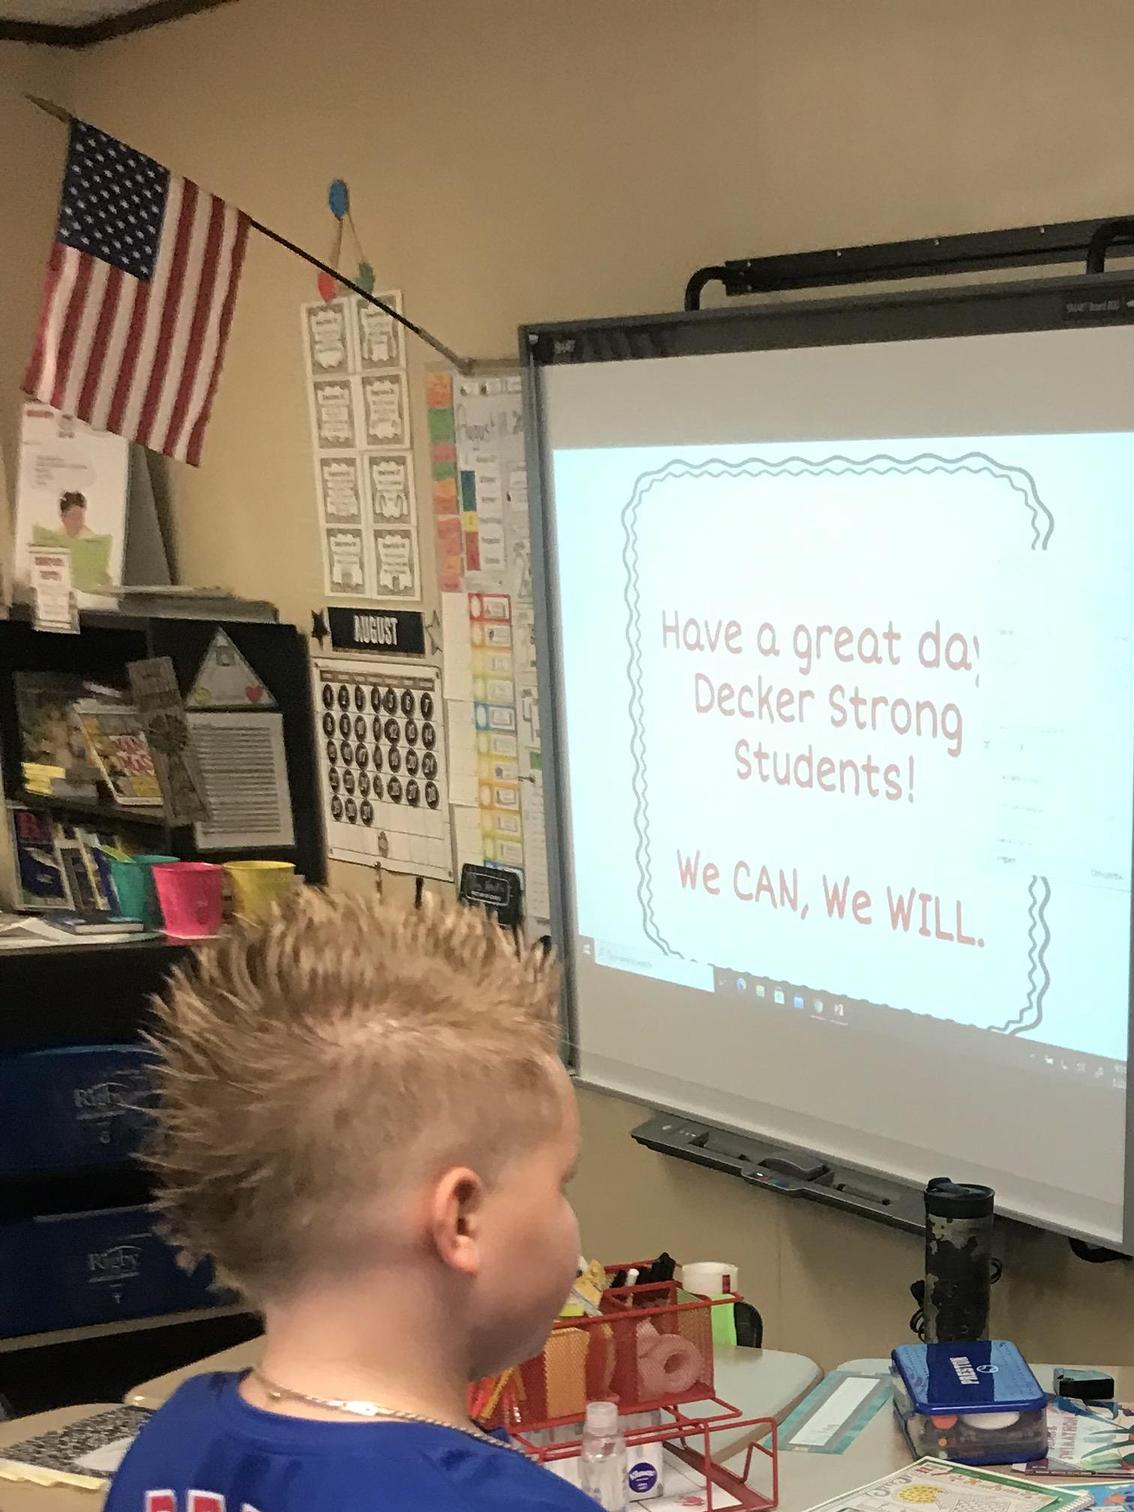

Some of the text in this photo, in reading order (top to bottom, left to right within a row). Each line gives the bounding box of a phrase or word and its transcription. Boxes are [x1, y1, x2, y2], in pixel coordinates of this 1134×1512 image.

[353, 615, 399, 646] AUGUST
[660, 608, 743, 656] Have
[756, 621, 781, 658] a
[793, 618, 902, 675] great
[693, 672, 963, 758] Decker Strong
[734, 737, 916, 804] Students!
[676, 848, 987, 948] We CAN, We WILL.
